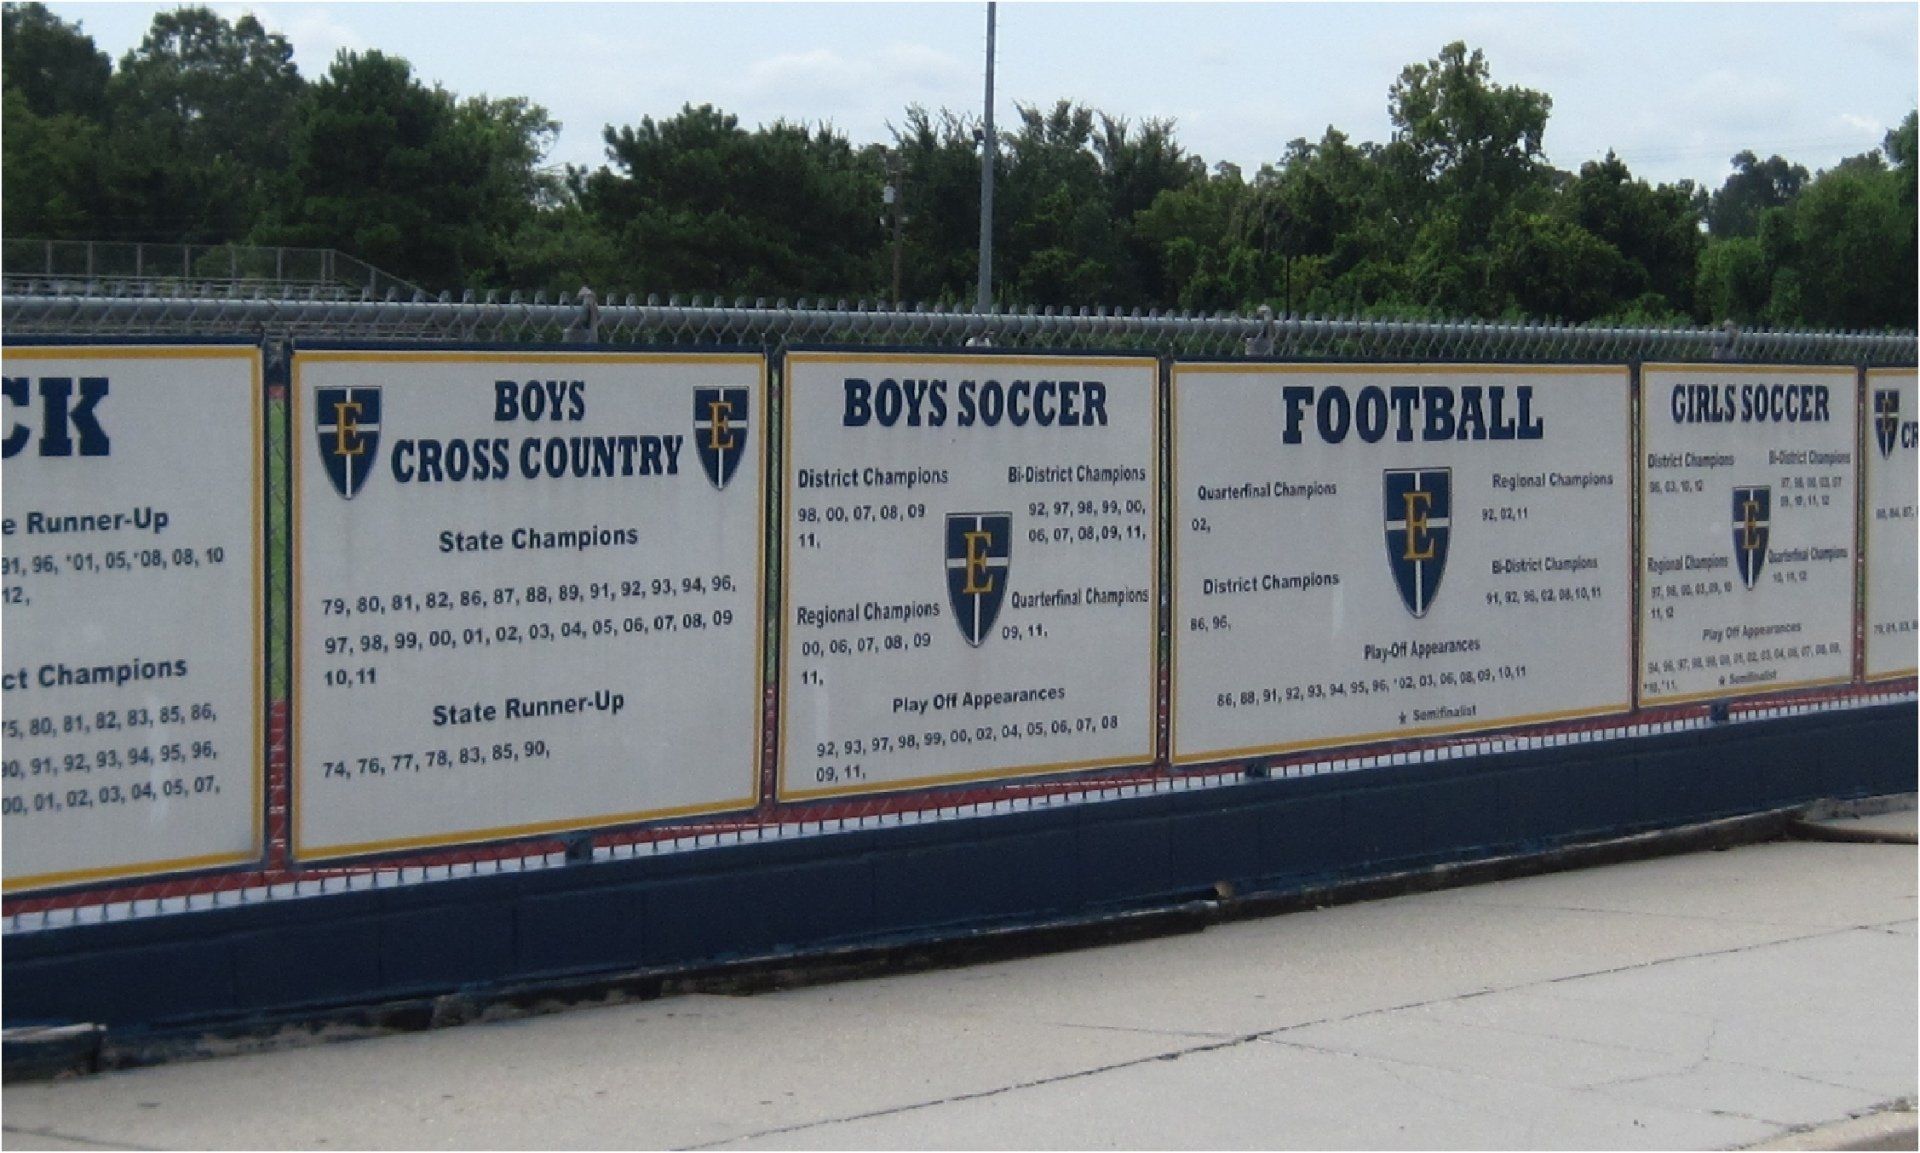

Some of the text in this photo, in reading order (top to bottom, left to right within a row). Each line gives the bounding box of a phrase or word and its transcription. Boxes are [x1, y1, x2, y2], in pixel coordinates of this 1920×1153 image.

[494, 380, 585, 423] BOYS
[843, 378, 1108, 427] BOYS SOCCER
[1283, 386, 1543, 444] FOOTBALL
[1671, 384, 1829, 424] GIRLS SOCCER
[334, 403, 364, 455] E
[708, 402, 734, 449] E
[391, 435, 683, 484] CROSS COUNTRY
[798, 467, 949, 489] District Champions
[1008, 465, 1145, 486] Bi-District Champions
[1492, 472, 1613, 492] Regional Champions
[1198, 481, 1336, 501] Quarterfinal Champions
[27, 507, 169, 534] Runner-Up
[798, 504, 925, 524] 98, 00, 07, 08, 09
[1029, 500, 1145, 518] 92, 97, 98, 99, 00,
[439, 525, 638, 553] State Champions
[799, 532, 820, 548] 11,
[1029, 525, 1146, 544] 06, 07, 11,
[1403, 492, 1434, 560] E
[32, 555, 58, 575] 96,
[172, 548, 199, 568] 08,
[206, 546, 225, 564] 10
[963, 532, 993, 593] E
[1492, 555, 1598, 574] Bi-District Champions
[322, 575, 736, 618] 79, 80, 81, 82, 86, 87, 88, 89, 91, 92, 93, 94, 96,
[1203, 571, 1340, 595] District Champions
[1012, 587, 1149, 609] Quarterfinal Champions
[797, 601, 940, 629] Regional Champions
[325, 610, 733, 655] 97, 98, 99, 00, 01, 02, 03, 04, 05, 06, 07, 08, 09
[802, 632, 931, 658] 00, 06, 07, 08, 09
[1364, 639, 1480, 663] Play-Off Appearances
[38, 658, 188, 688] Champions
[801, 670, 823, 686] 11,
[433, 690, 624, 727] State Runner-Up
[893, 688, 1065, 715] Play Off Appearances
[1413, 705, 1478, 723] Semifinalist
[29, 703, 216, 737] 80, 81, 82, 83, 85, 86,
[817, 715, 1117, 759] 92, 93, 97, 98, 99, 00, 02, 04, 05, 06, 07, 08
[30, 741, 217, 776] 91, 92, 93, 94, 95, 96,
[323, 740, 550, 779] 74, 76, 77, 78, 83, 85, 90,
[816, 764, 866, 783] 09, 11,
[34, 775, 220, 812] 01, 02, 03, 04, 05, 07,
